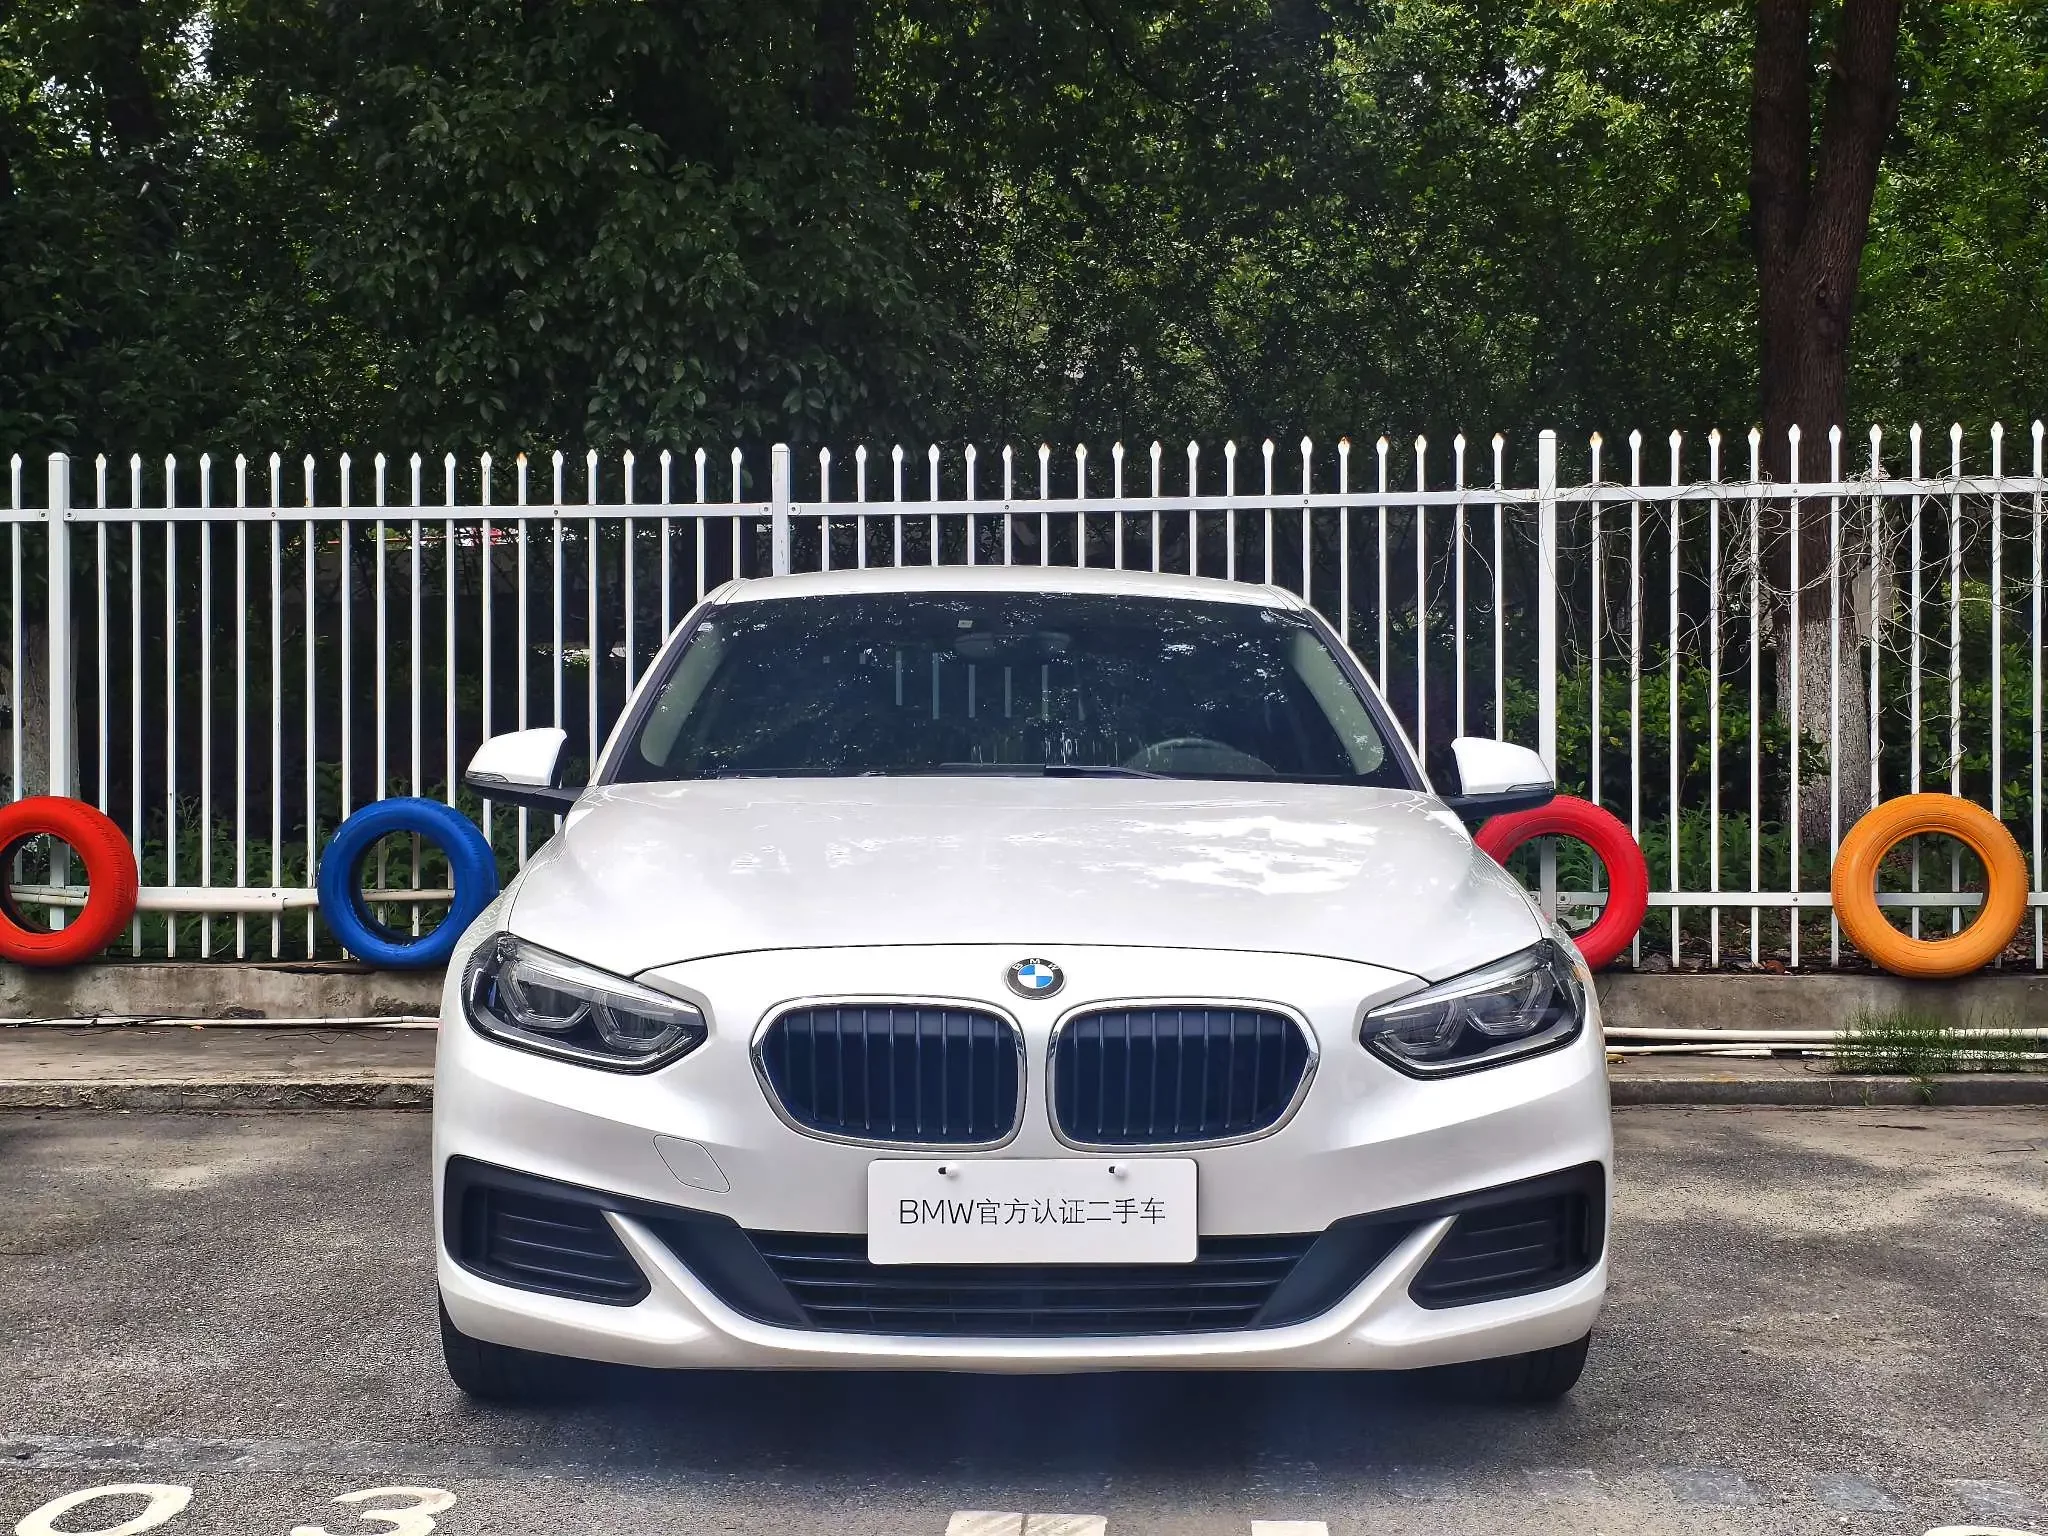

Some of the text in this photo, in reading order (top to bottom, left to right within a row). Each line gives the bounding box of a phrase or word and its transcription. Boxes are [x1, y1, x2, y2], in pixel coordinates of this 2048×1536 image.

[1011, 958, 1060, 971] BMW
[899, 1197, 1166, 1226] BMW官方认证二手车
